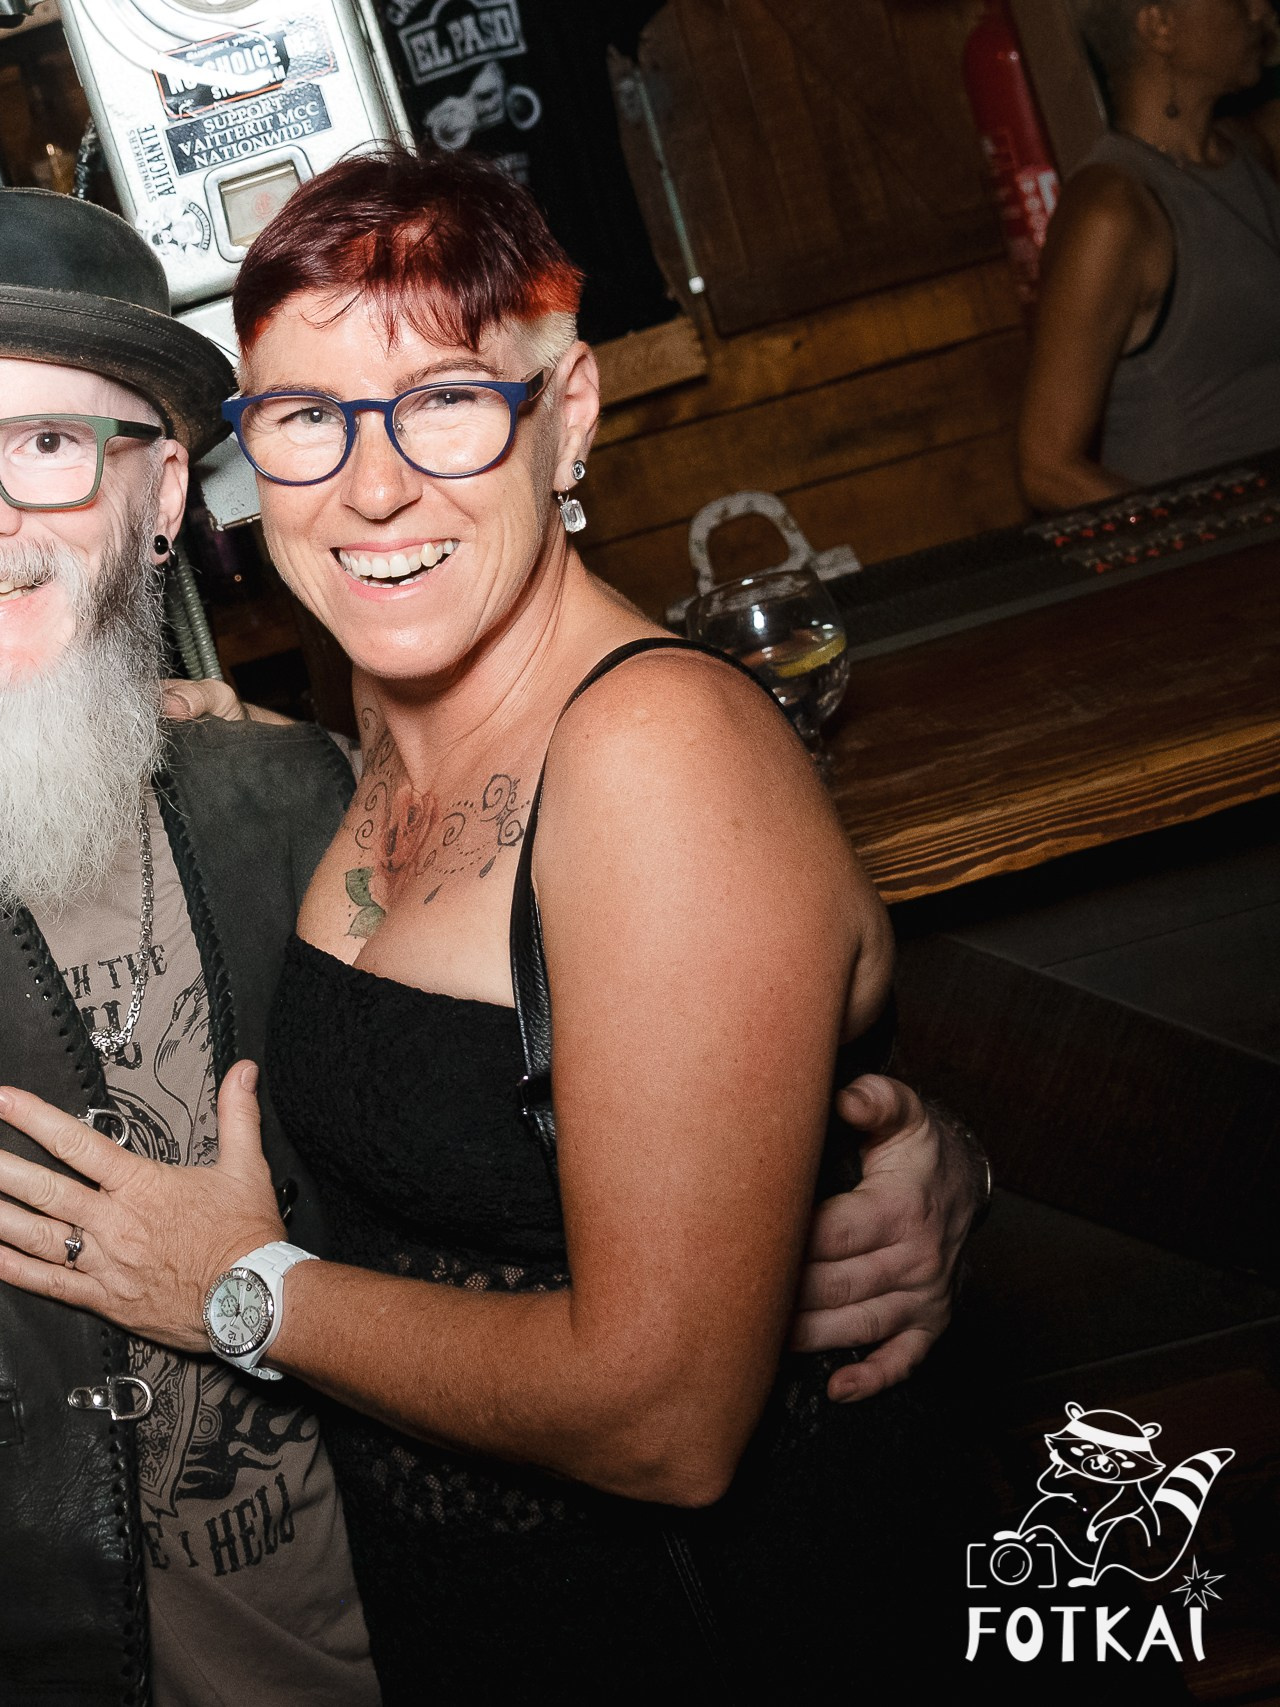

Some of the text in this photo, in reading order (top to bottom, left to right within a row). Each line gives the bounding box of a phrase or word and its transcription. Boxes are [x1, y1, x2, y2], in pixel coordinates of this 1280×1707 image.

[409, 30, 454, 72] EL
[446, 8, 516, 60] PASO
[203, 95, 284, 133] SUPPORT
[277, 101, 320, 127] MCC
[136, 124, 177, 197] ALICANTE
[192, 119, 316, 170] NATIONWIDE
[97, 944, 168, 990] THE
[204, 1472, 296, 1577] HELL
